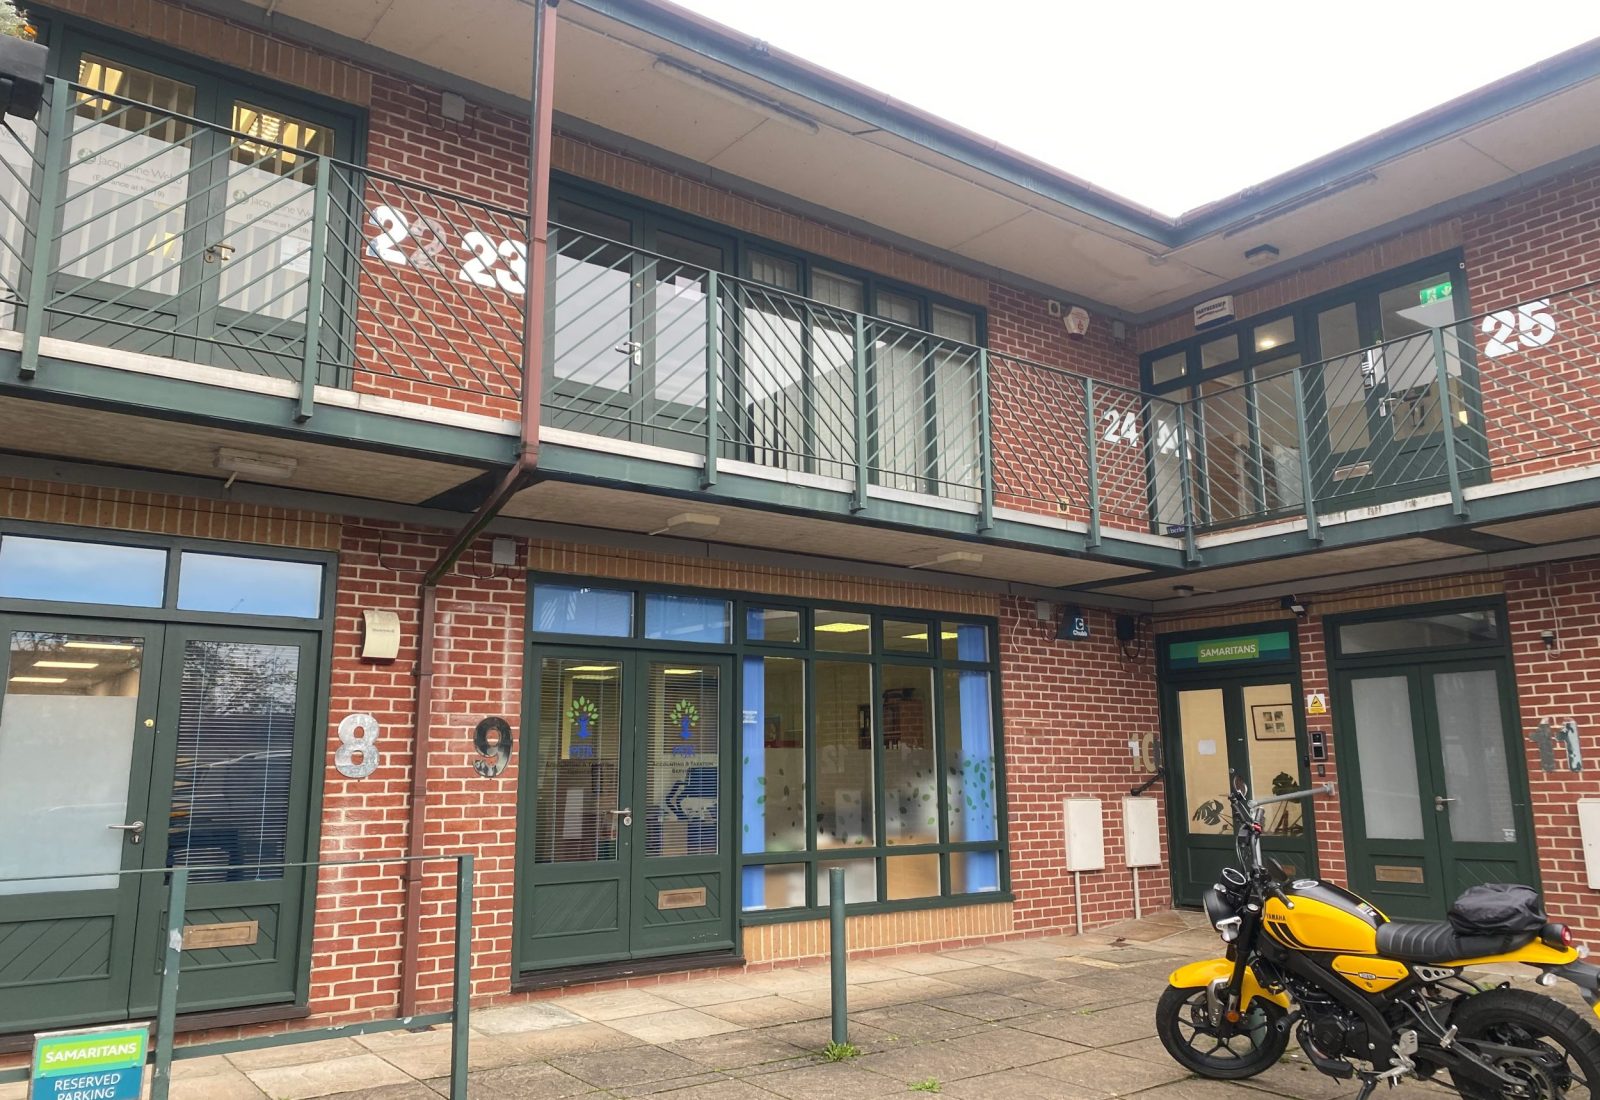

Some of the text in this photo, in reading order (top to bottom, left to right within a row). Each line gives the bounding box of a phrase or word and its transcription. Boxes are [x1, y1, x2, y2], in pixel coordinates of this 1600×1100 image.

[96, 156, 150, 177] Jacquine
[93, 174, 129, 190] (Eance
[251, 196, 295, 215] Jacqune
[366, 205, 446, 273] 22
[459, 231, 526, 294] 23
[1482, 299, 1556, 358] 25
[1103, 409, 1139, 447] 24
[1200, 644, 1256, 658] SAMARITANS
[334, 713, 380, 778] 8
[473, 716, 513, 777] 9
[1128, 731, 1161, 772] 10
[1529, 716, 1582, 773] 11
[1266, 913, 1286, 921] YAMAHA
[45, 1042, 137, 1064] SAMARITANS
[54, 1073, 121, 1092] RESERVED
[57, 1087, 116, 1100] PARKING
